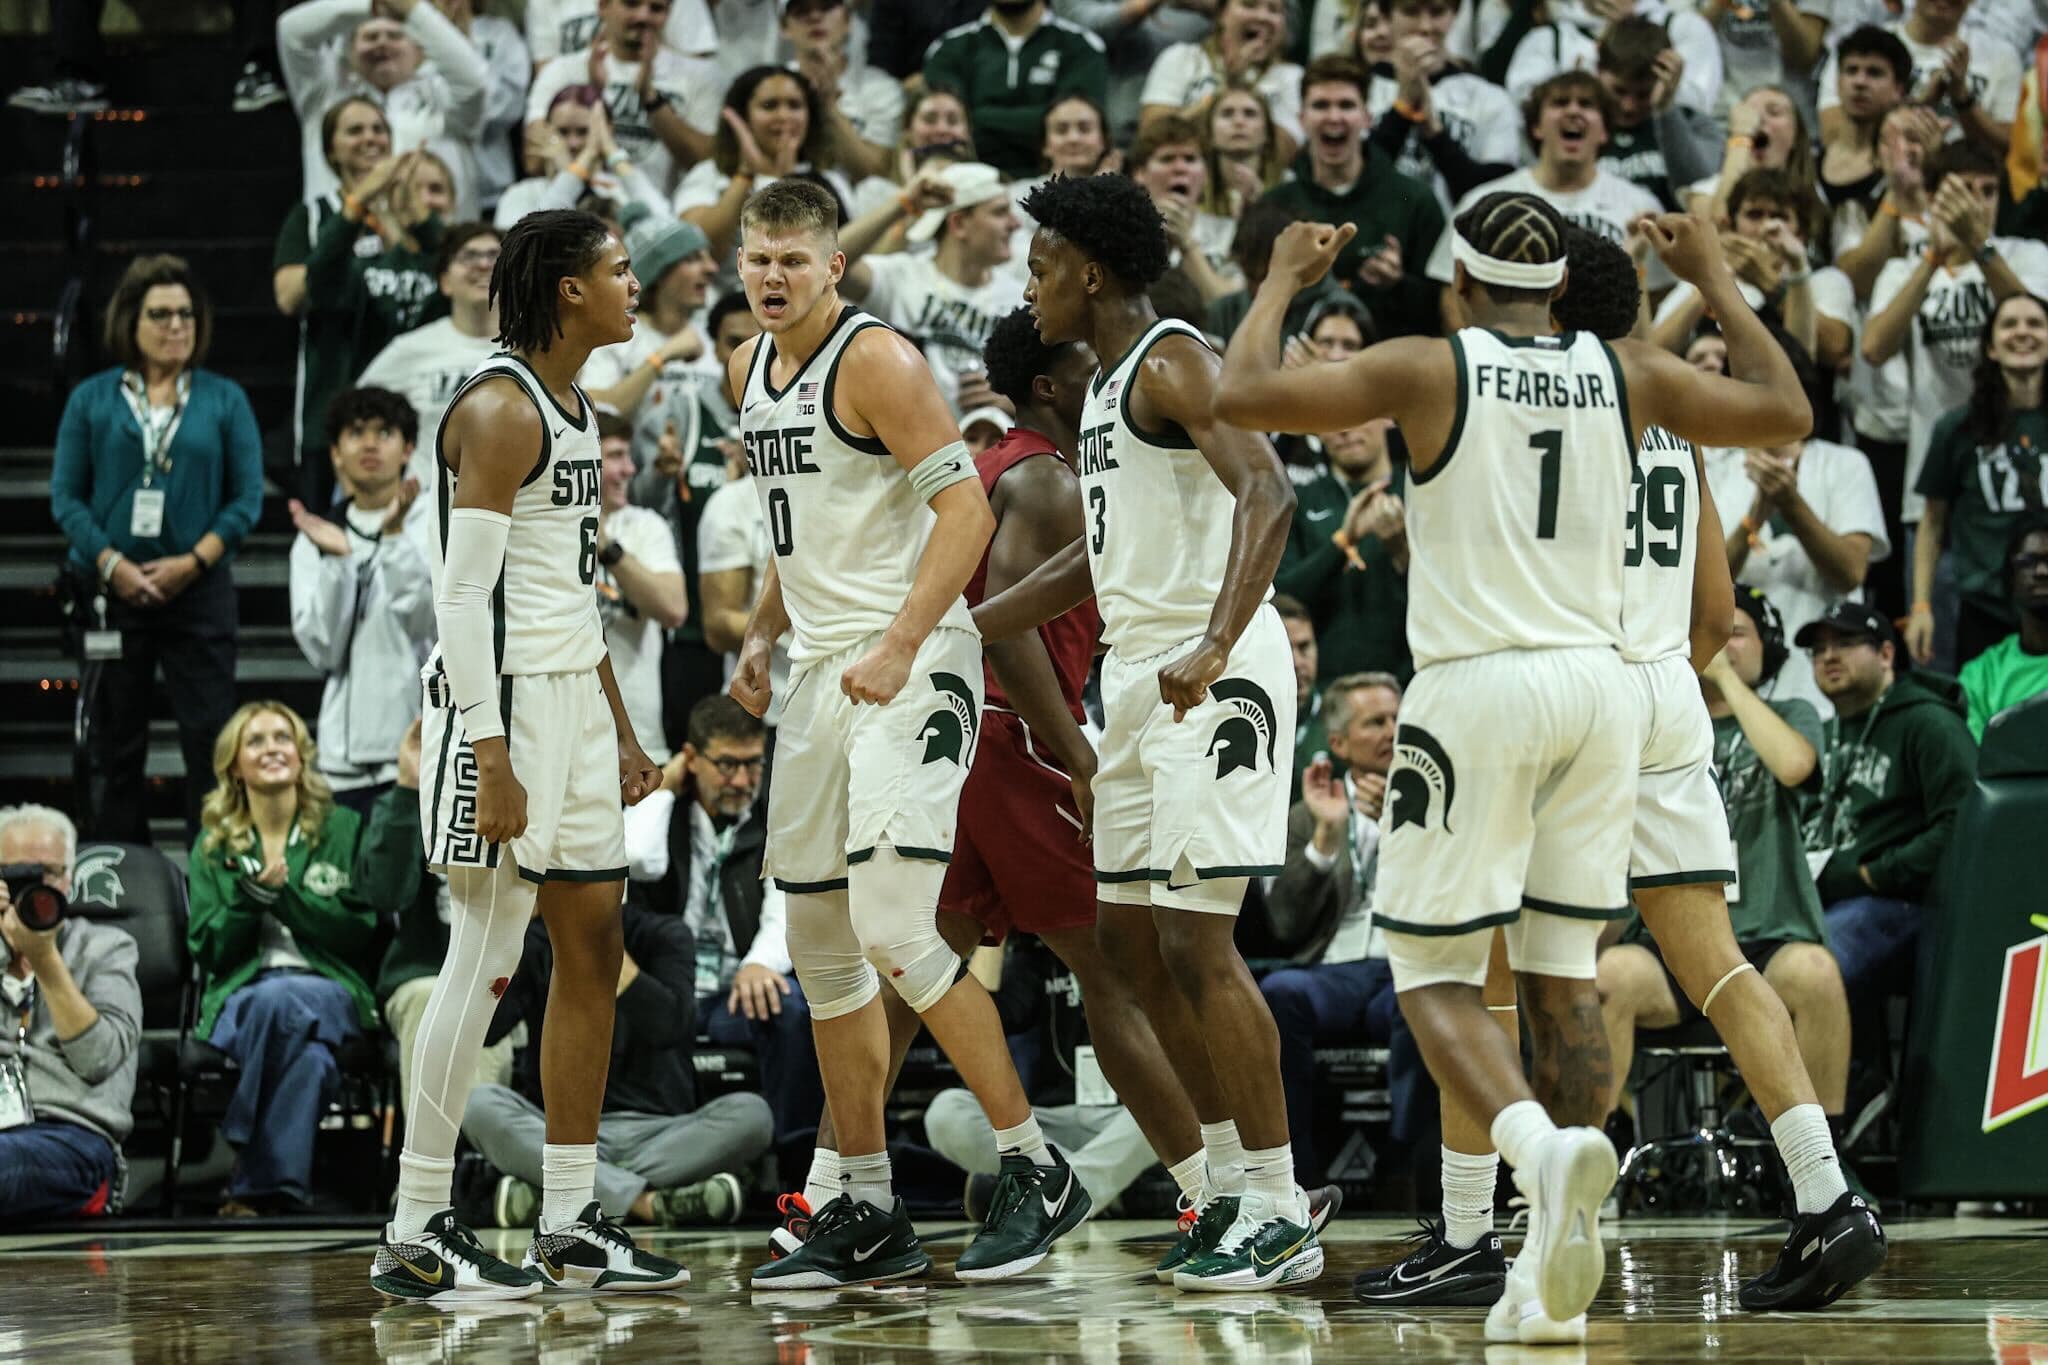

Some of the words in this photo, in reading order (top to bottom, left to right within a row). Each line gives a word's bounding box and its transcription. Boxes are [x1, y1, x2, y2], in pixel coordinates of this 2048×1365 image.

[1476, 364, 1569, 408] FEARS
[1573, 373, 1616, 409] JR.
[744, 427, 822, 477] STATE
[1528, 429, 1563, 540] 1
[578, 517, 599, 585] 6
[769, 488, 794, 557] 0
[1089, 485, 1106, 555] 3
